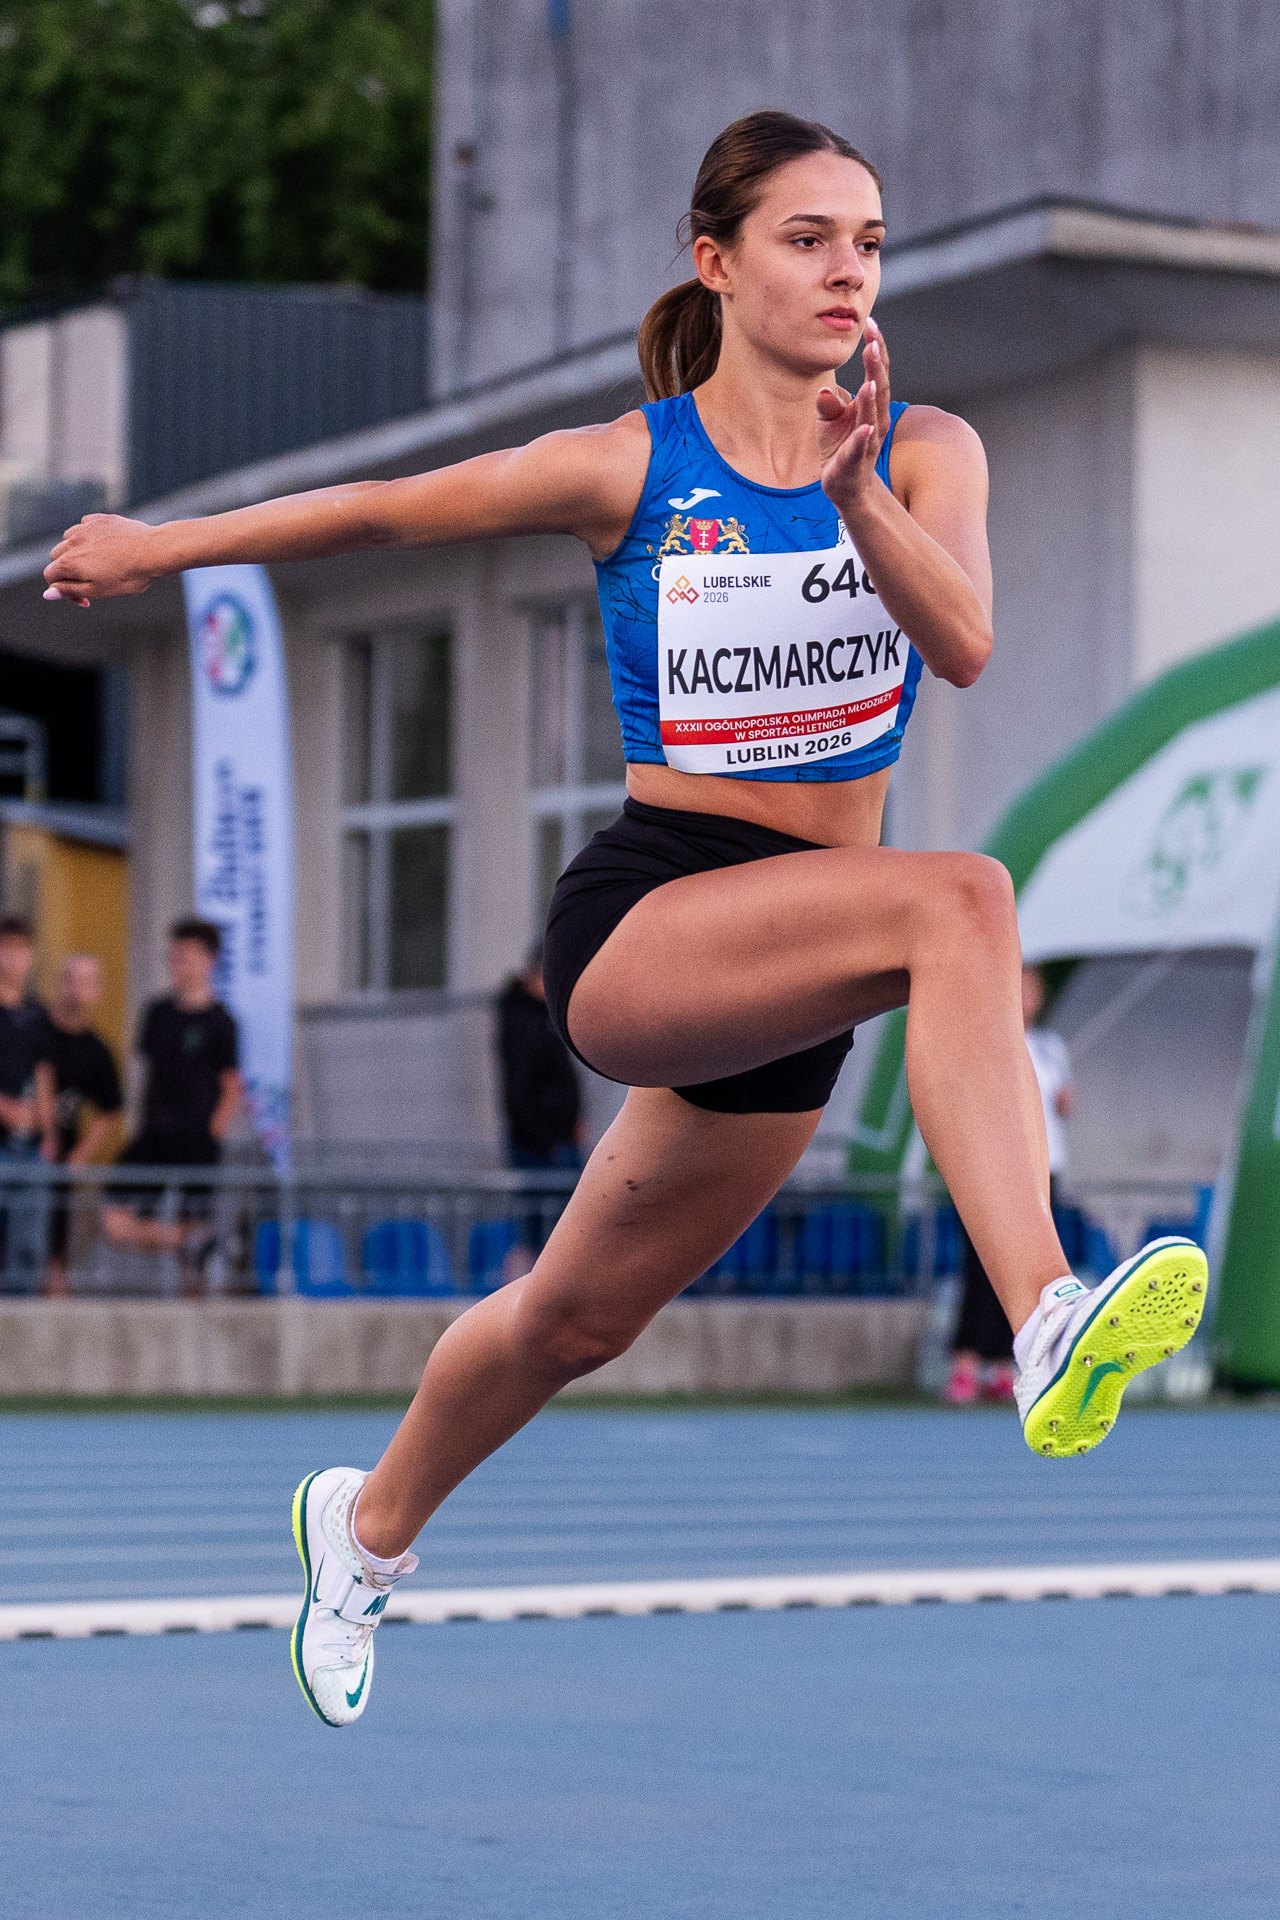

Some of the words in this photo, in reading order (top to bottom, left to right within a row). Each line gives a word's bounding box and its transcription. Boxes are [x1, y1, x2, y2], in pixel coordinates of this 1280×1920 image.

[703, 575, 772, 588] LUBELSKIE
[703, 591, 729, 603] 2026
[667, 628, 902, 695] KACZMARCZYK
[675, 722, 703, 733] XXXII
[704, 715, 790, 732] OGÓLNOPOLSKA
[791, 707, 846, 724] OLIMPIADA
[847, 691, 894, 715] MŁODZIEŻY
[734, 731, 746, 741] W
[748, 725, 805, 740] SPORTACH
[806, 717, 847, 733] LETNICH
[726, 743, 799, 765] LUBLIN
[804, 731, 852, 756] 2026
